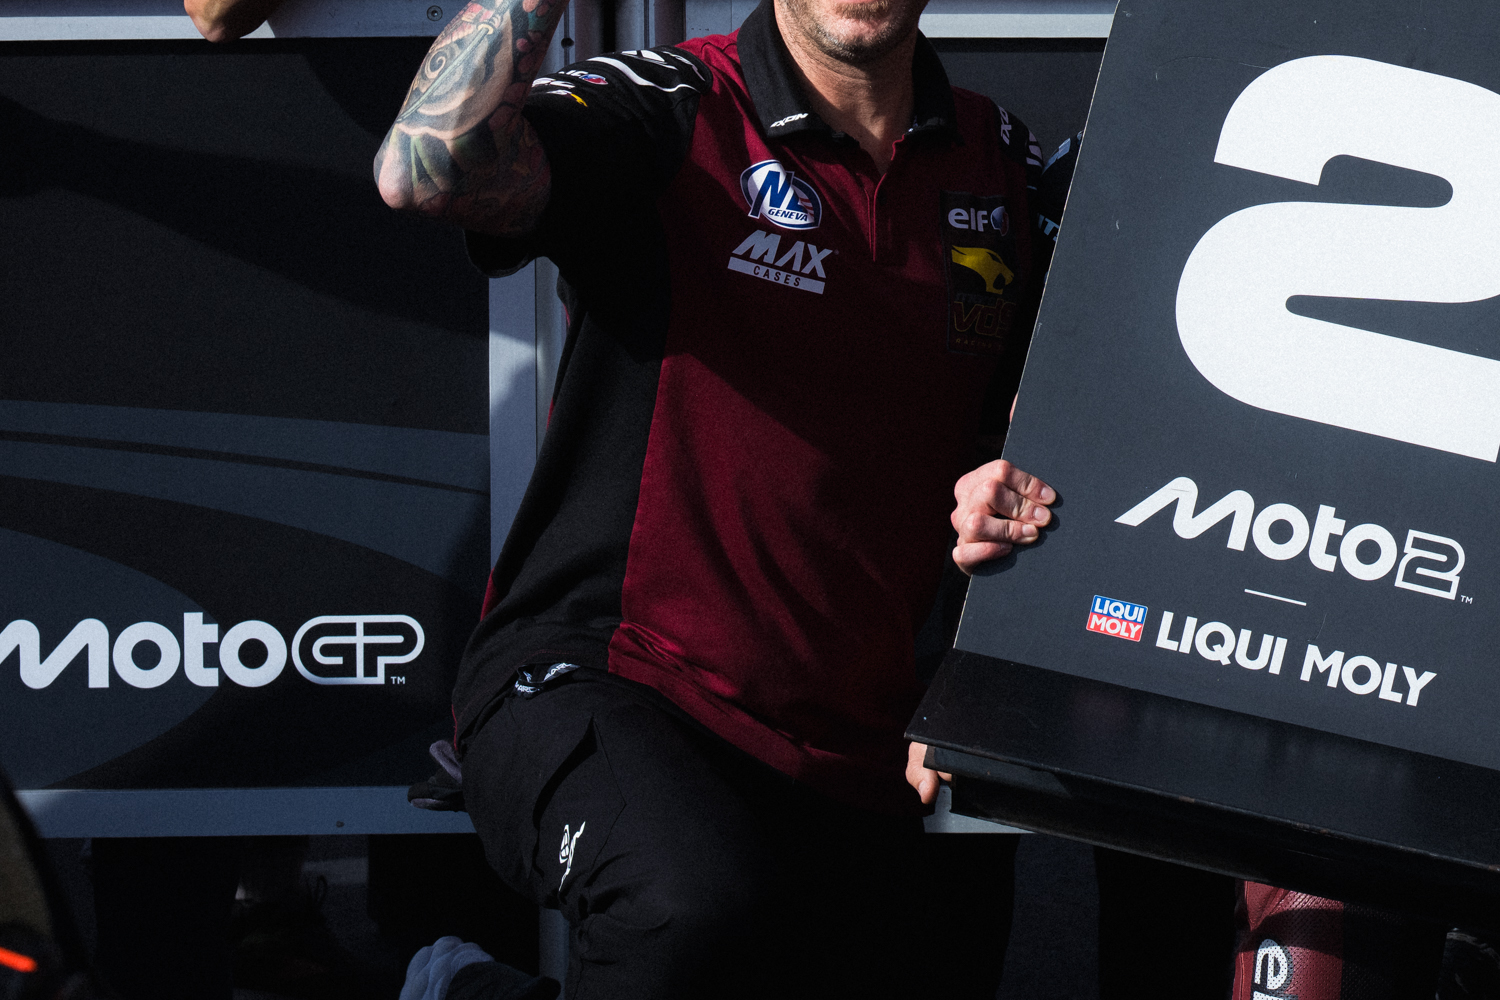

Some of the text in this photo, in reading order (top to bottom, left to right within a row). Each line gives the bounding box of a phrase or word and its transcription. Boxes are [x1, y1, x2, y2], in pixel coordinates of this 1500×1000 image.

[768, 208, 808, 222] GENEVA
[948, 207, 989, 232] elf
[732, 229, 834, 279] MAX
[753, 265, 801, 287] CASES
[1114, 476, 1466, 600] Moto2
[1093, 597, 1147, 623] LIQUI
[1089, 615, 1142, 640] MOLY
[0, 611, 425, 690] MotoGP
[1156, 610, 1437, 707] LIQUI MOLY
